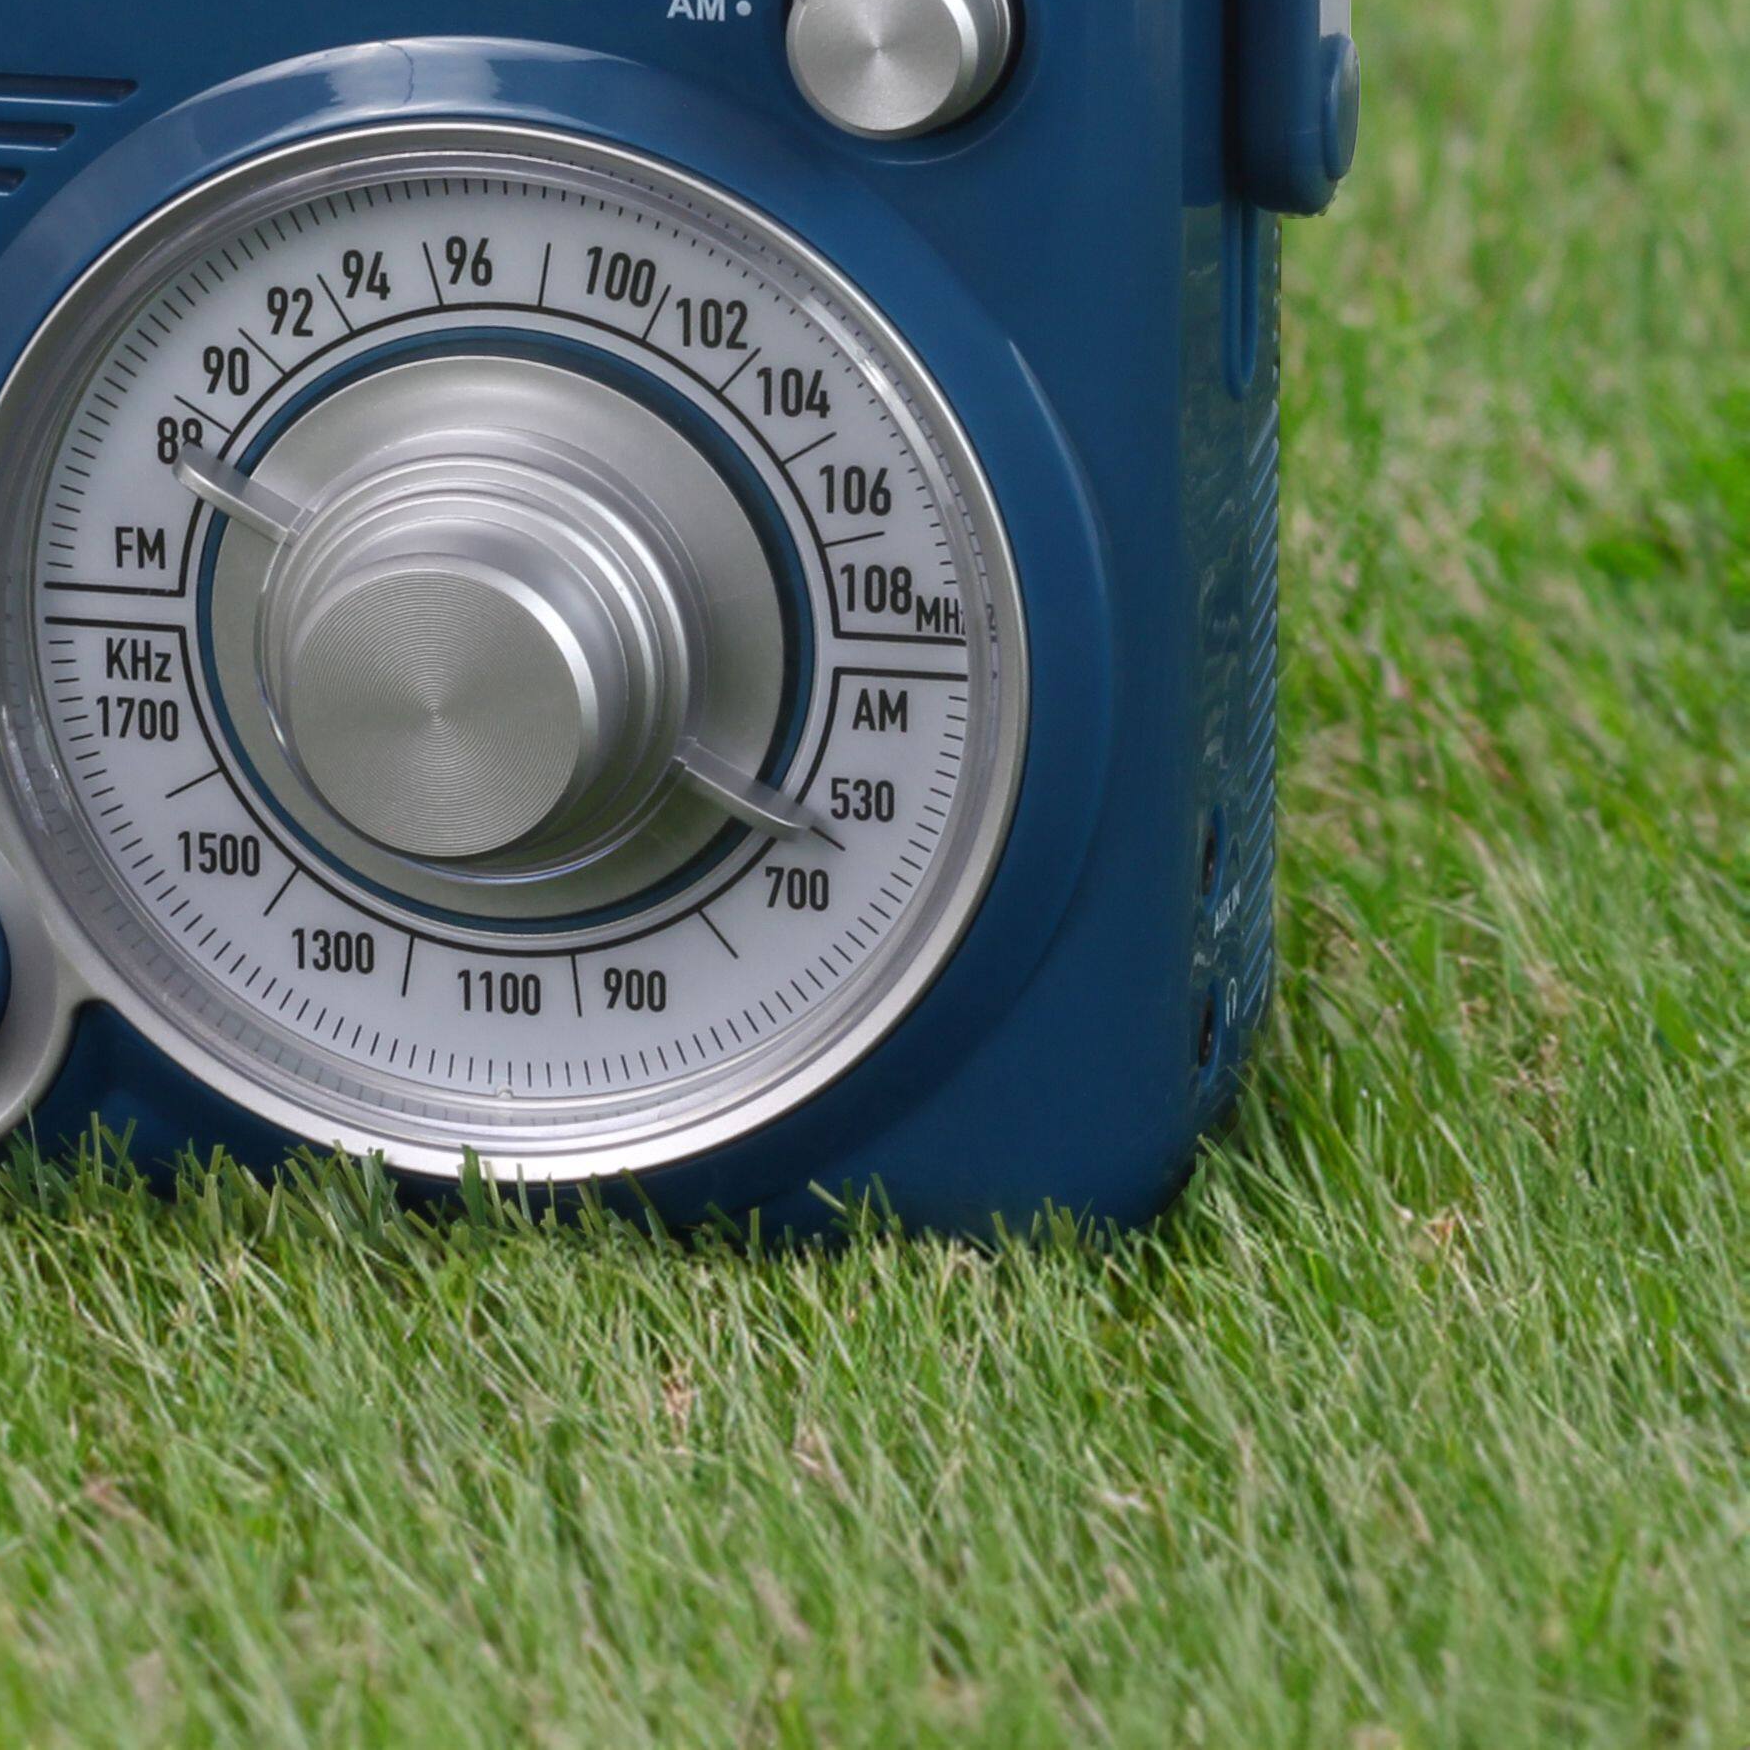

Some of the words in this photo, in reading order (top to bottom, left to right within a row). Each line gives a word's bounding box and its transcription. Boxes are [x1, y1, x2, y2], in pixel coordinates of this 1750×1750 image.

[342, 250, 391, 300] 94
[445, 236, 493, 287] 96
[585, 245, 657, 308] 100
[267, 287, 313, 337] 92
[675, 298, 749, 350] 102
[202, 346, 250, 396] 90
[756, 367, 831, 419] 104
[819, 465, 892, 517] 106
[115, 526, 166, 569] FM
[840, 564, 913, 614] 108
[106, 637, 172, 683] KHz
[95, 695, 179, 742] 1700
[852, 688, 908, 734] AM
[830, 777, 895, 823] 530
[177, 830, 261, 877] 1500
[764, 866, 830, 911] 700
[291, 928, 375, 975] 1300
[457, 969, 542, 1016] 1100
[603, 967, 667, 1013] 900
